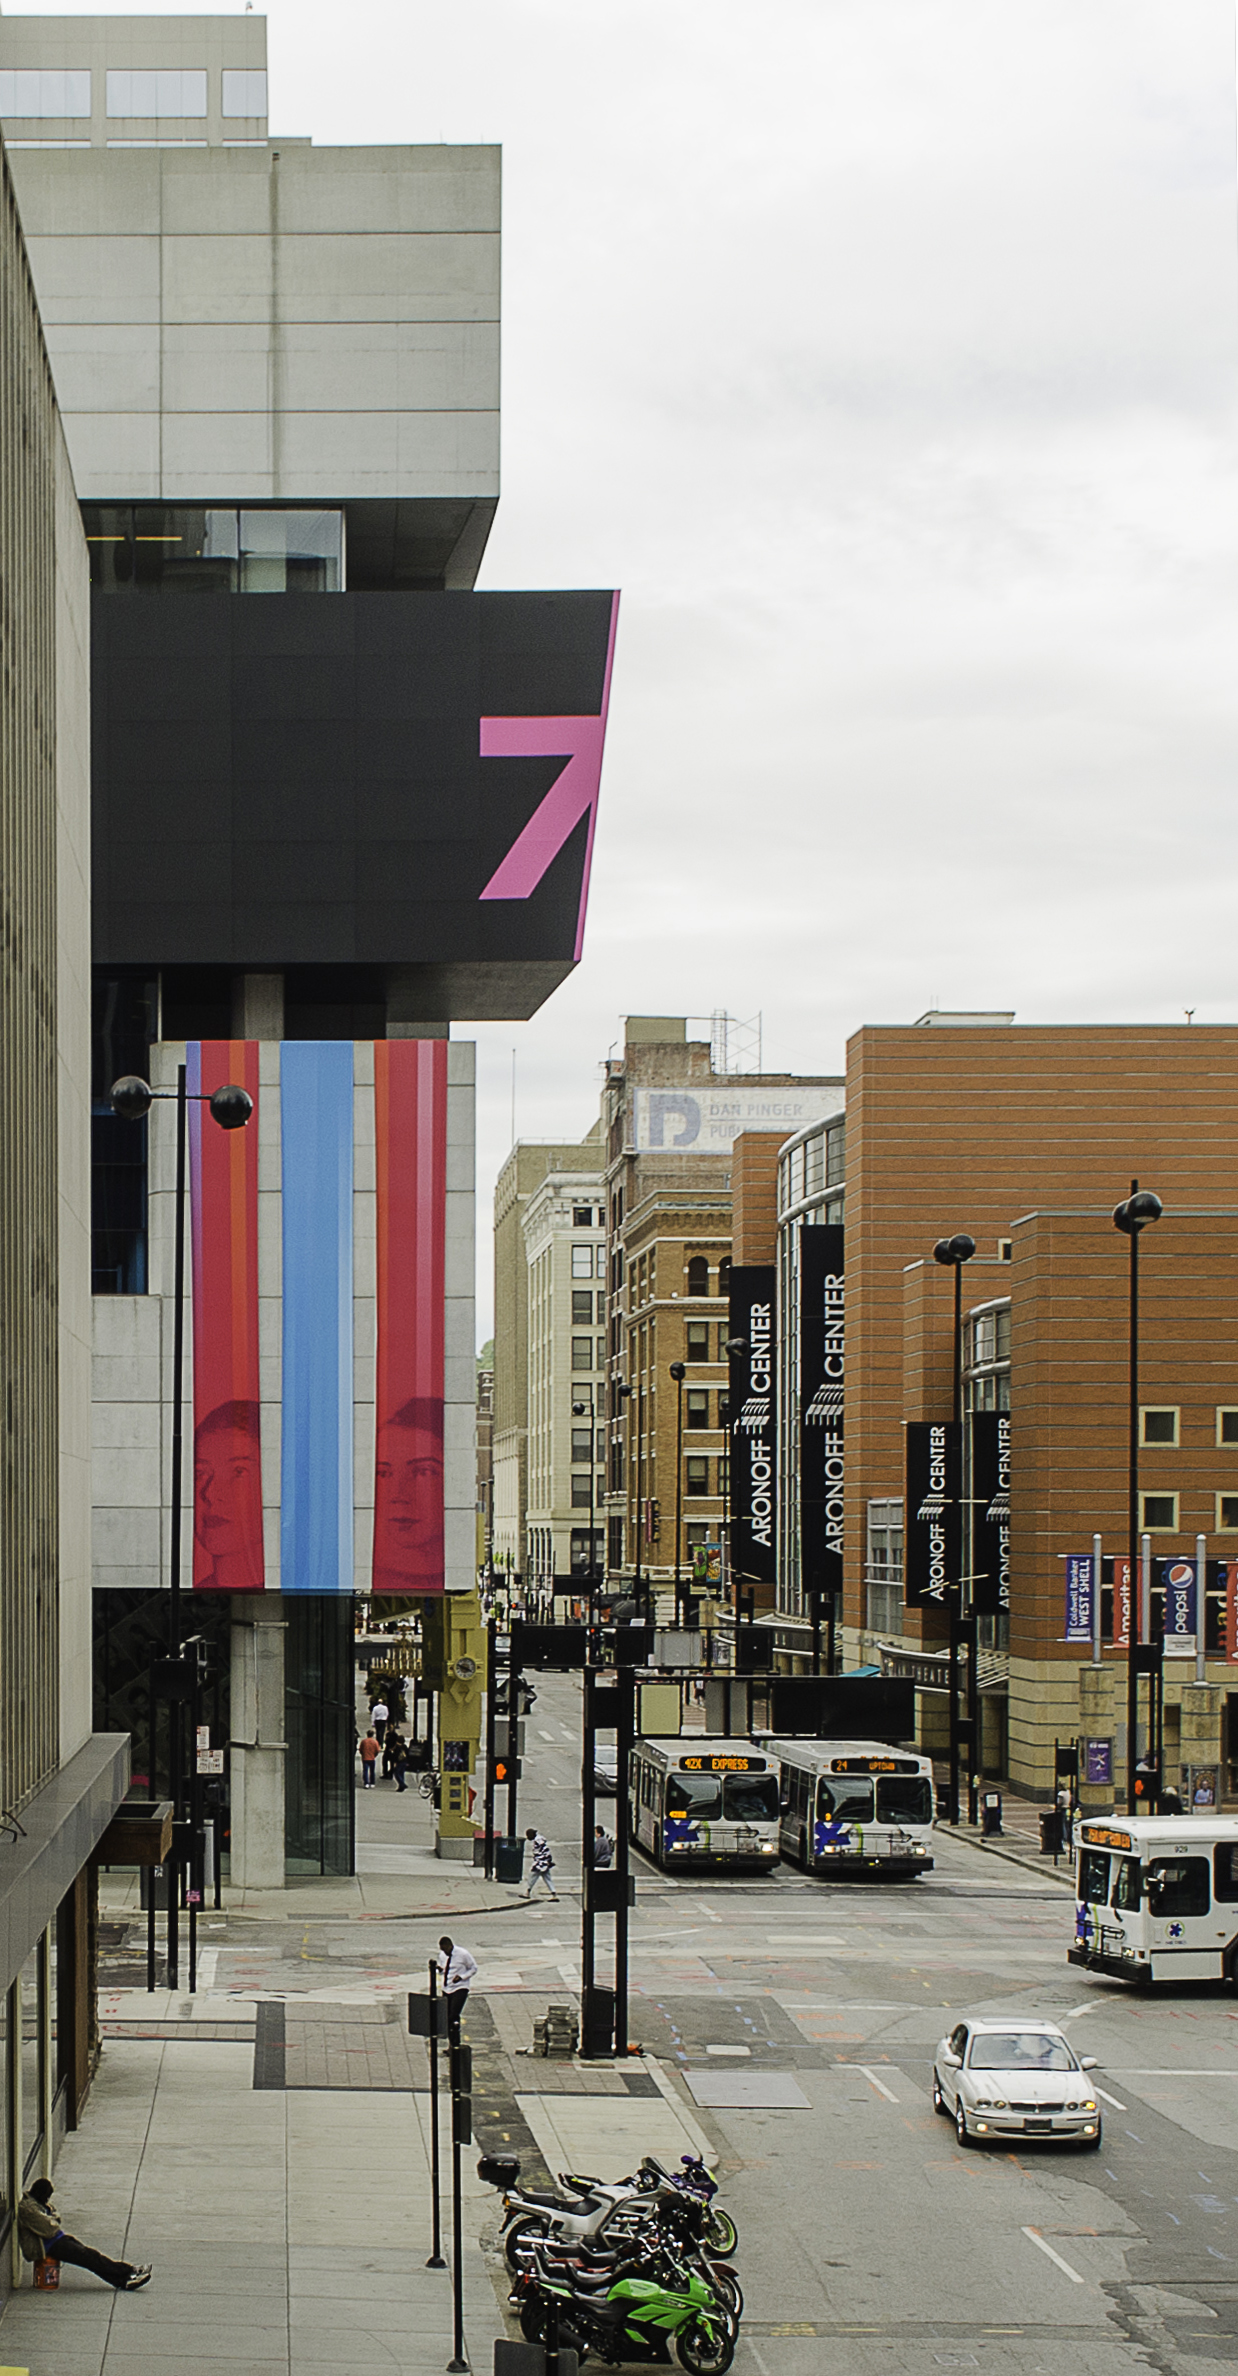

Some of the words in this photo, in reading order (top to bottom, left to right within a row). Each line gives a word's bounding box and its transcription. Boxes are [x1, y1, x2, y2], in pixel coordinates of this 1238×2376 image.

[479, 715, 605, 899] 7
[709, 1103, 741, 1116] DAN
[747, 1103, 803, 1116] PINGER
[750, 1302, 771, 1393] CENTER
[824, 1273, 845, 1378] CENTER
[929, 1426, 945, 1491] CENTER
[751, 1438, 772, 1547] ARONOFF
[824, 1431, 845, 1555] ARONOFF
[929, 1523, 945, 1601] ARONOFF
[1069, 1560, 1079, 1589] Banker
[1079, 1559, 1091, 1593] SHELL
[1069, 1590, 1079, 1627] Coldwell
[1079, 1597, 1091, 1627] WEST
[1118, 1564, 1131, 1645] Ameritas
[1174, 1590, 1189, 1634] pepsi
[684, 1757, 702, 1770] 42X
[711, 1757, 749, 1771] EXPRESS
[836, 1759, 848, 1772] 24
[868, 1761, 896, 1771] UPTOWN
